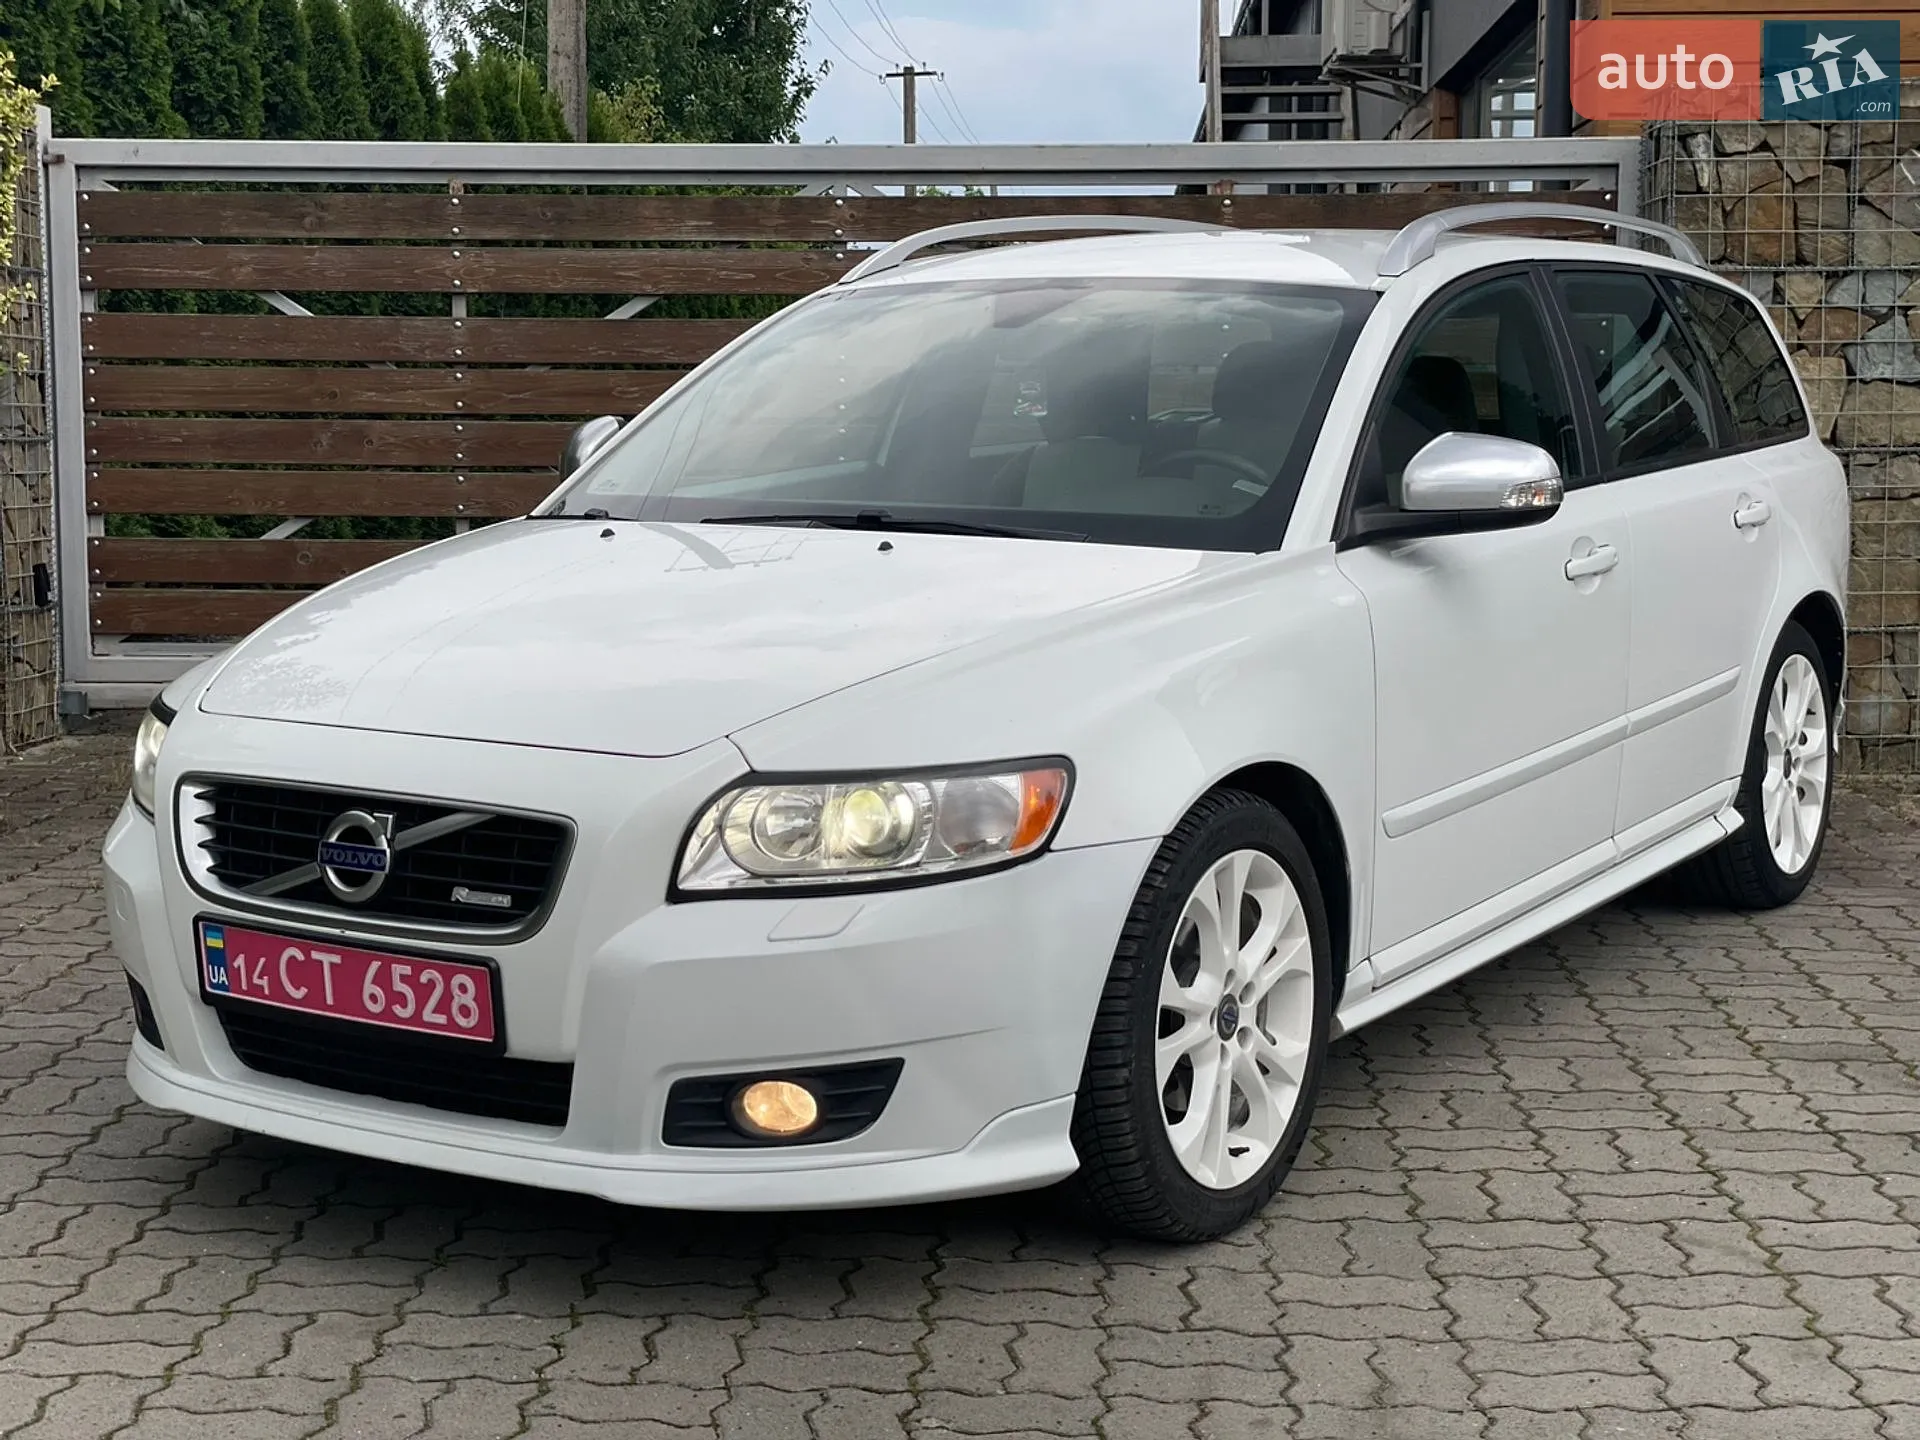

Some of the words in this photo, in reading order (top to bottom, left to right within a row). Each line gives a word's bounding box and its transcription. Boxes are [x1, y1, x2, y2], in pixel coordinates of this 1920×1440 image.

[320, 847, 388, 868] VOLVO
[208, 965, 229, 986] UA
[362, 960, 480, 1029] 6528
